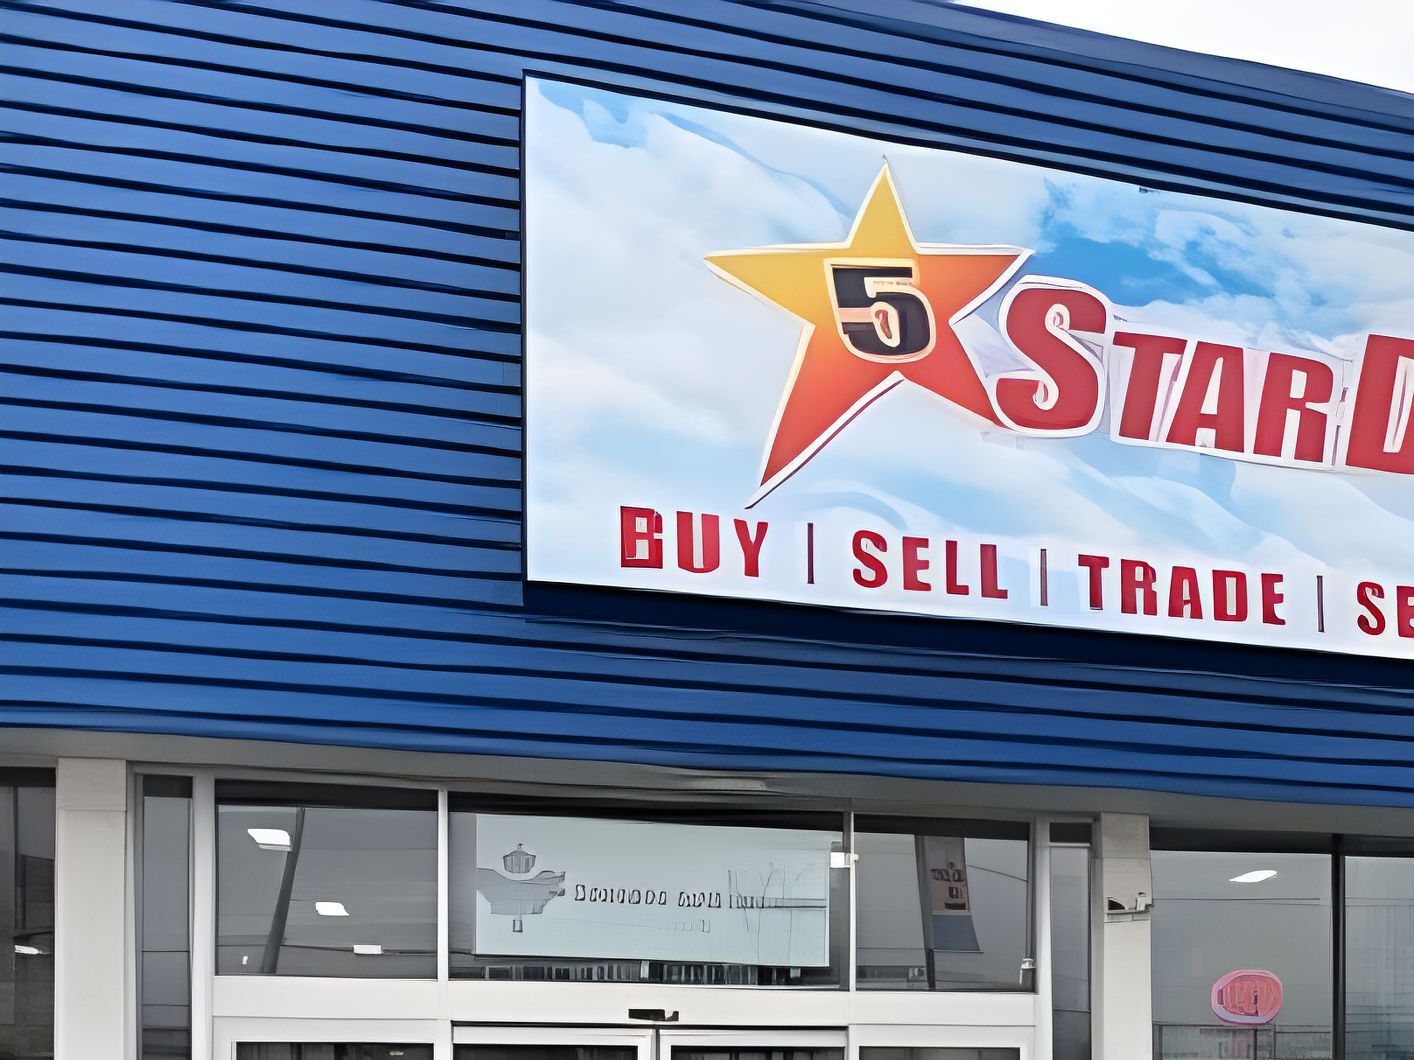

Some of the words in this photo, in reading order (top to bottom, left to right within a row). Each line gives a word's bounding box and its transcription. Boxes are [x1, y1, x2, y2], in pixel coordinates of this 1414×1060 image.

[827, 261, 937, 360] 5
[620, 506, 769, 577] BUY
[852, 530, 1008, 599] SELL
[1078, 554, 1285, 625] TRADE
